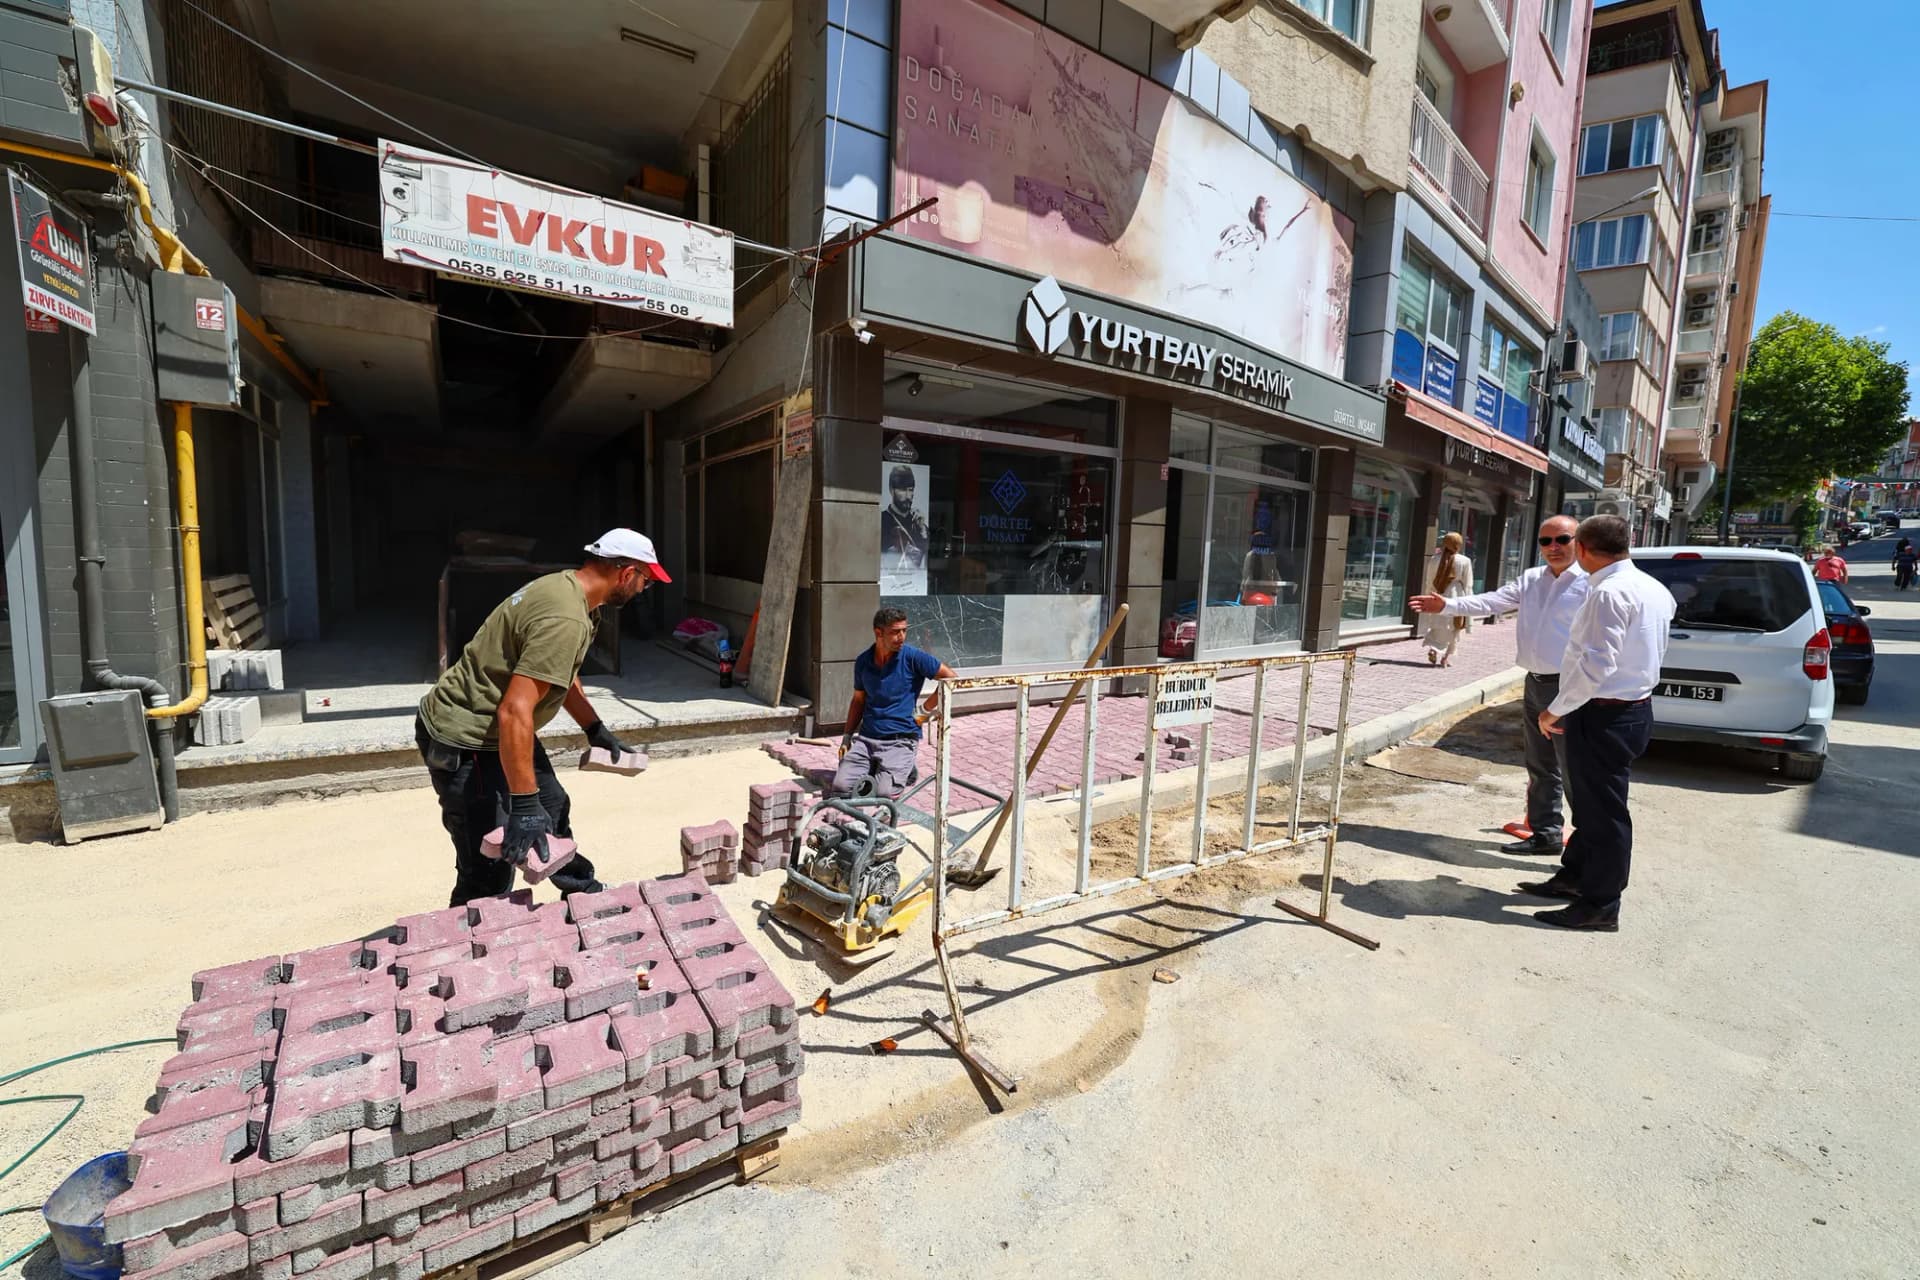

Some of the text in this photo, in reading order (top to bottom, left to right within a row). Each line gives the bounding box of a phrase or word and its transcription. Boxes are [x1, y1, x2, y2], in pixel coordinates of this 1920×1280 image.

[906, 55, 1039, 135] DOĞADAN
[904, 95, 1017, 156] SANATA
[391, 227, 468, 255] KULLANILMIŞ
[472, 243, 486, 257] VE
[490, 246, 514, 264] YENİ
[518, 254, 532, 267] EV
[466, 194, 668, 278] EVKUR
[448, 258, 496, 277] 0535
[503, 270, 537, 285] 625
[544, 278, 563, 291] 51
[197, 306, 222, 321] 12
[646, 299, 689, 316] 55 08
[1077, 311, 1294, 400] YURTBAY SERAMİK
[1165, 678, 1206, 693] BURDUR
[1664, 685, 1716, 700] AJ 153
